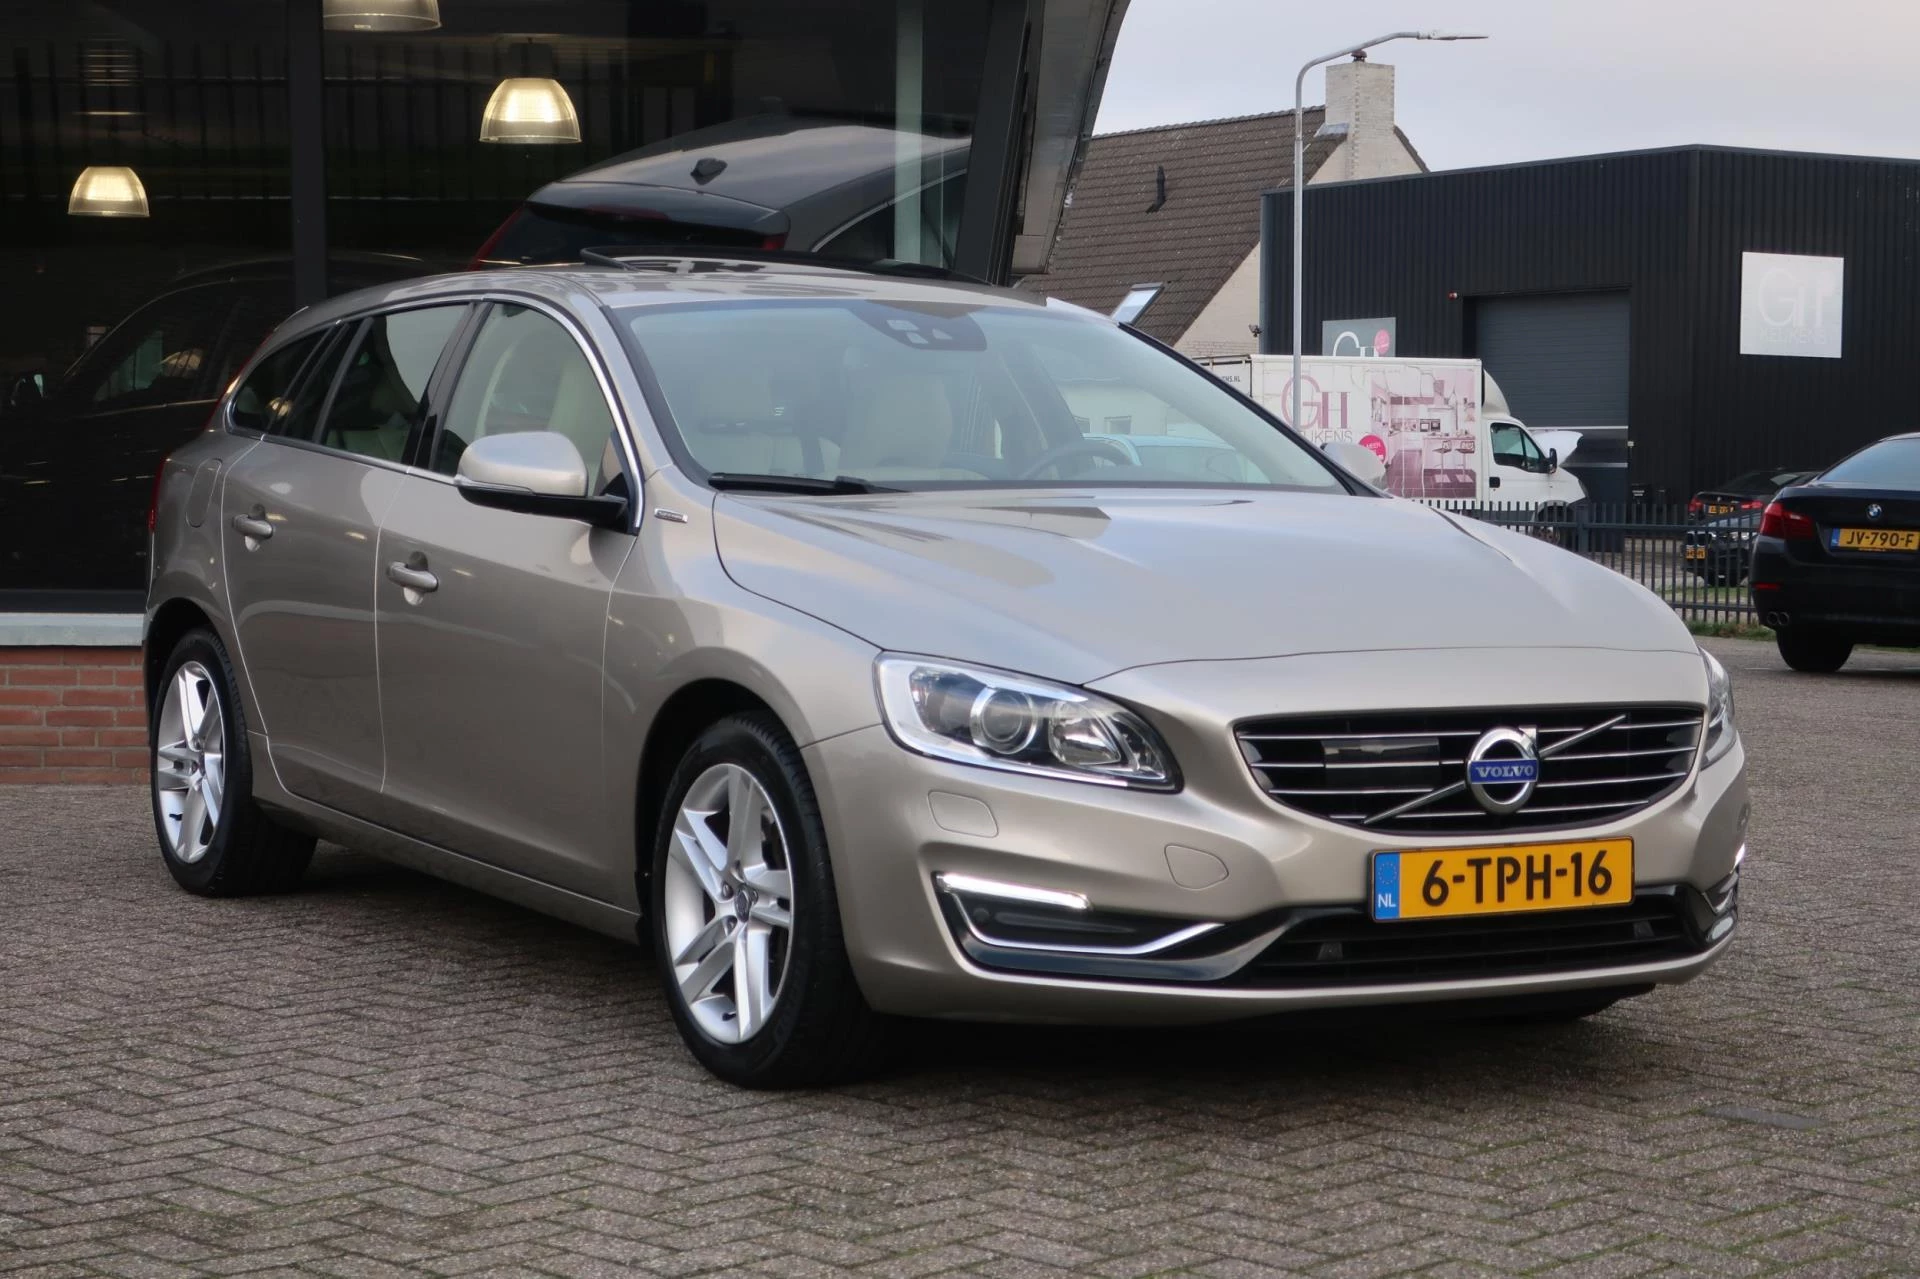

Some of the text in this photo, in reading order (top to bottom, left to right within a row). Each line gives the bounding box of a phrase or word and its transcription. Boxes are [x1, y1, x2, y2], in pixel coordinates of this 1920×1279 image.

[1846, 531, 1914, 548] JV-790-F
[1476, 763, 1535, 779] VOLVO
[1421, 849, 1613, 907] 6-TPH-16
[1378, 893, 1397, 908] NL
